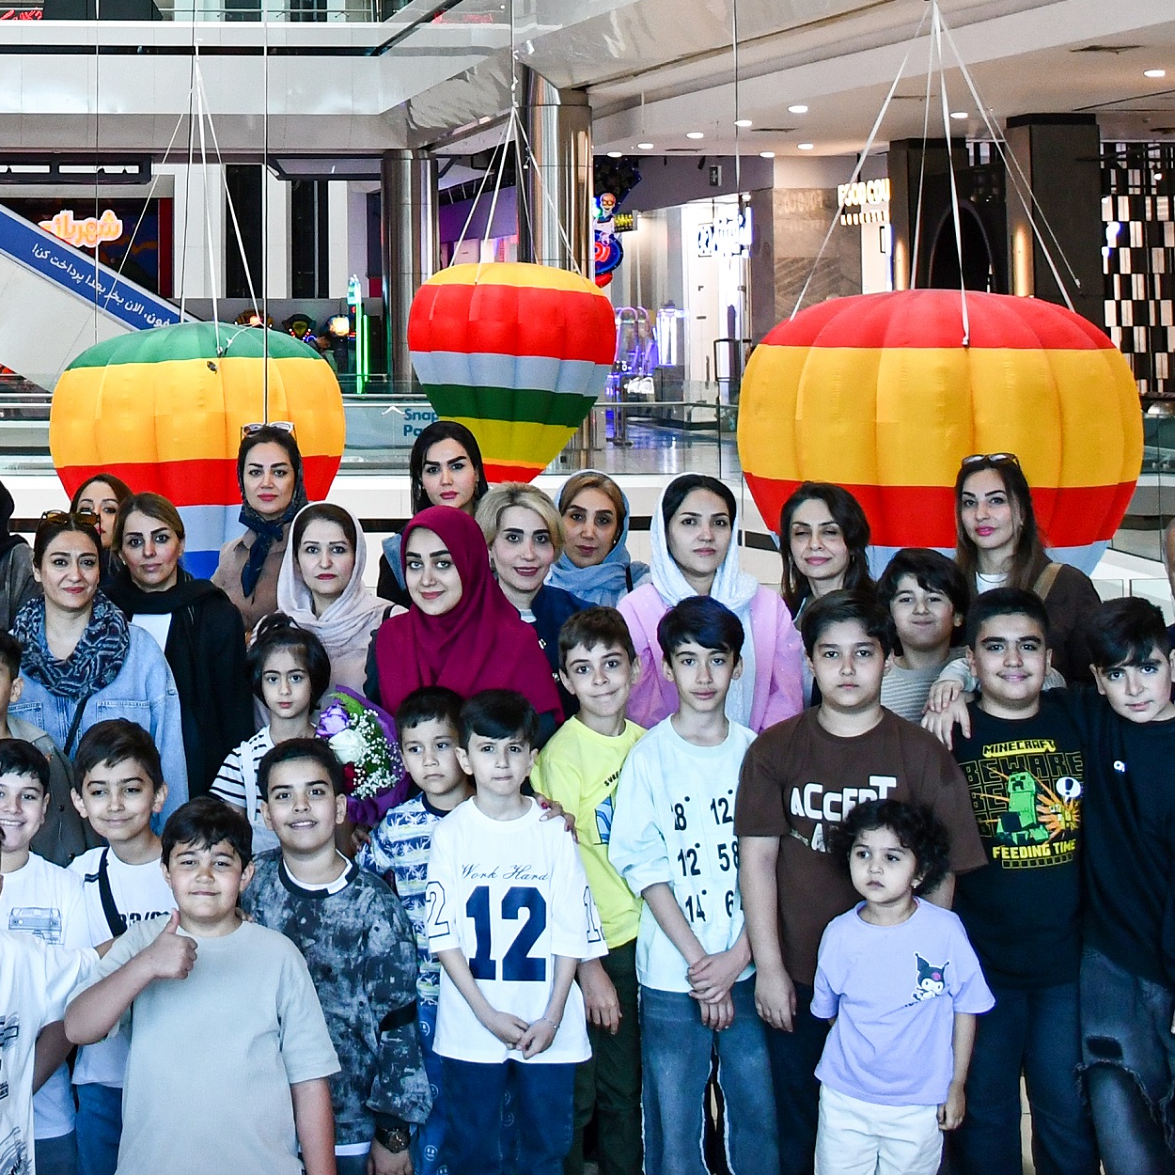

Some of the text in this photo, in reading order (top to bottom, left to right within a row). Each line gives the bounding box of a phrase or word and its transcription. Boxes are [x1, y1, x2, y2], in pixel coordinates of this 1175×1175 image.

[403, 407, 439, 423] Snap
[403, 424, 423, 437] Pa
[983, 739, 1057, 758] MINECRAFT
[958, 751, 1084, 786] BEWARE
[993, 838, 1076, 859] FEEDING TIME
[461, 863, 548, 881] Work Hard
[465, 885, 547, 982] 12
